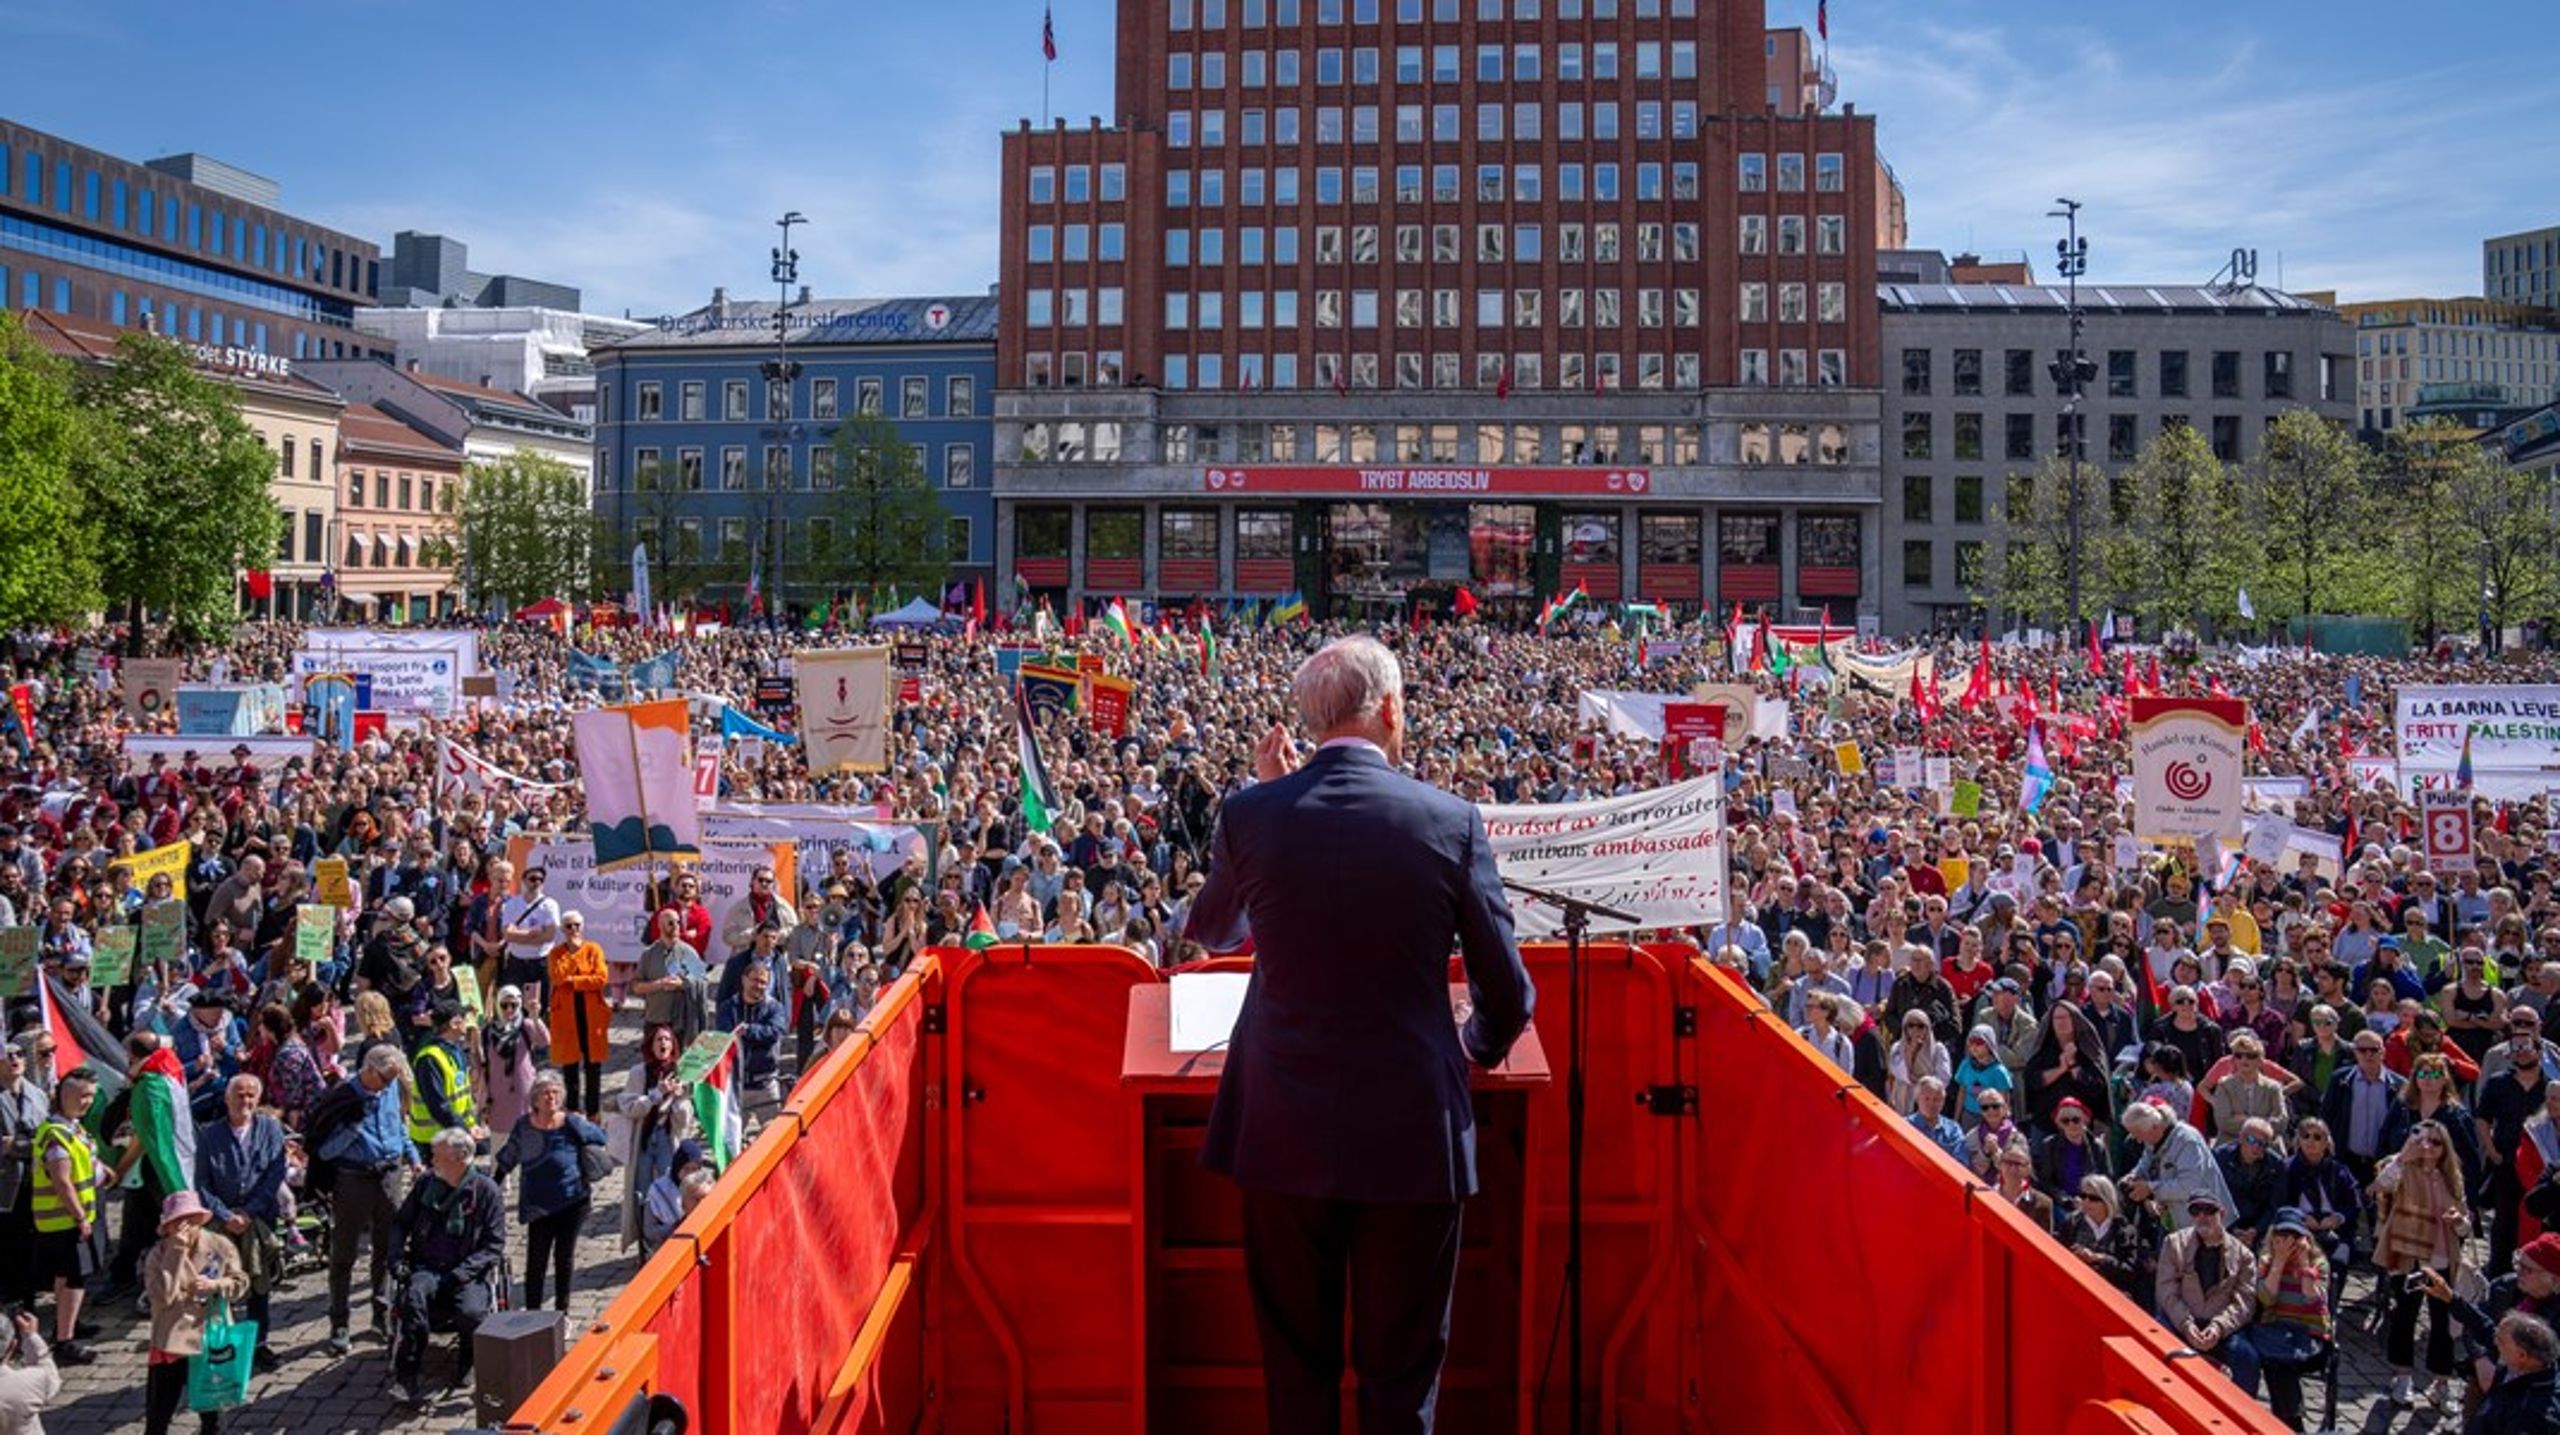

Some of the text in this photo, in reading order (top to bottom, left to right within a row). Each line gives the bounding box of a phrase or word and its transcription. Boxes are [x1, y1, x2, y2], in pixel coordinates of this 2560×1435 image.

[706, 312, 769, 331] Norske
[777, 309, 908, 332] uristforening
[226, 346, 290, 377] STYRKE
[1359, 471, 1489, 489] TRYGT ARBEIDSLIV
[2412, 700, 2560, 719] LA BARNA LEVE
[2405, 723, 2459, 739] FRITT
[700, 759, 714, 792] 7
[2426, 792, 2468, 806] Pulje
[2434, 812, 2466, 852] 8
[542, 853, 568, 870] Nei
[566, 879, 584, 891] av
[588, 875, 631, 892] kultur
